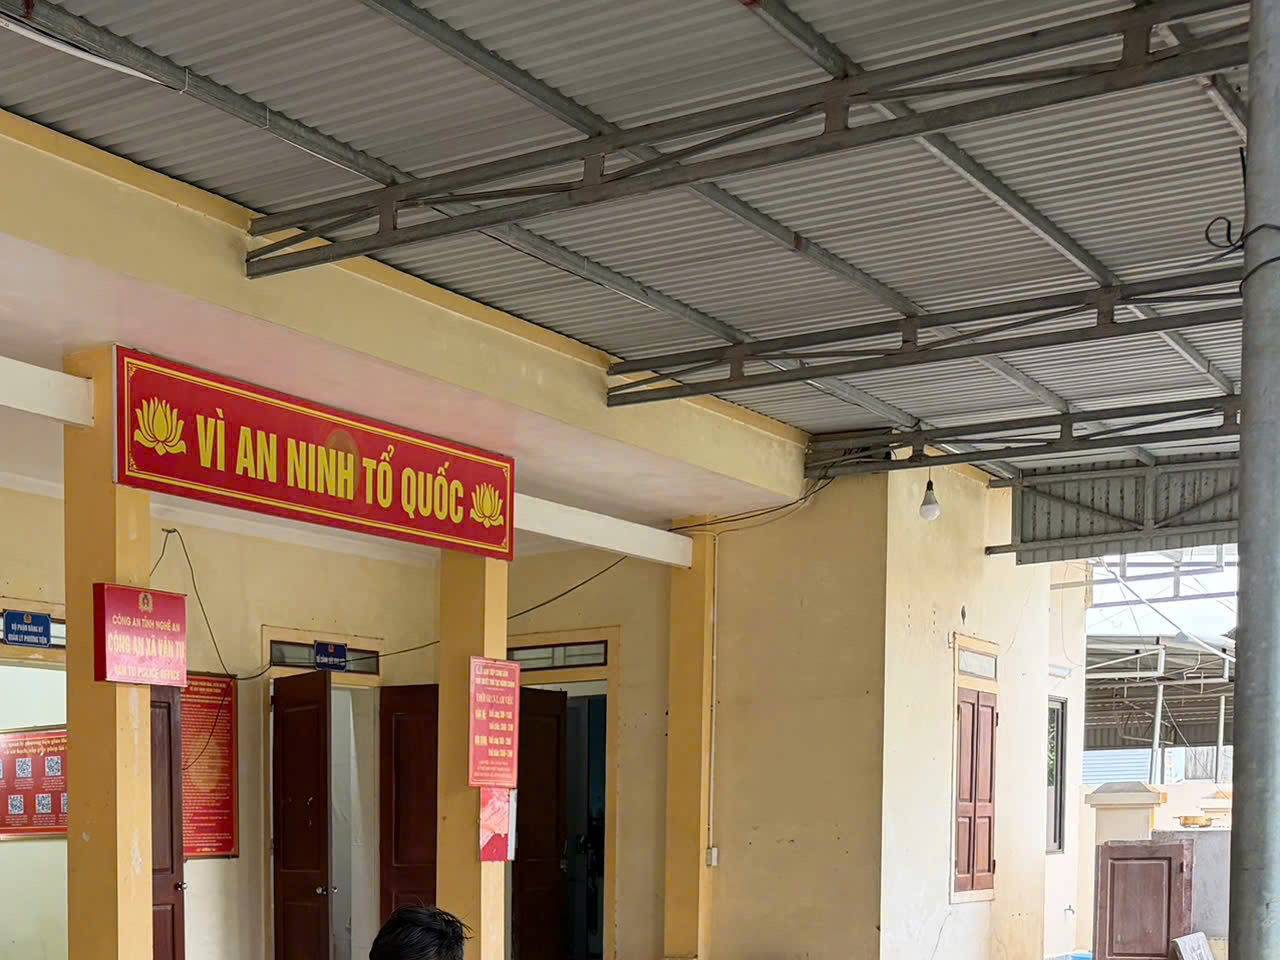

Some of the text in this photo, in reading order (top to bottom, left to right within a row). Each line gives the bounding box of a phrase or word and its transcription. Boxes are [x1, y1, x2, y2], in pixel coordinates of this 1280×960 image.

[196, 407, 464, 524] VÌ AN NINH TỔ QUỐC
